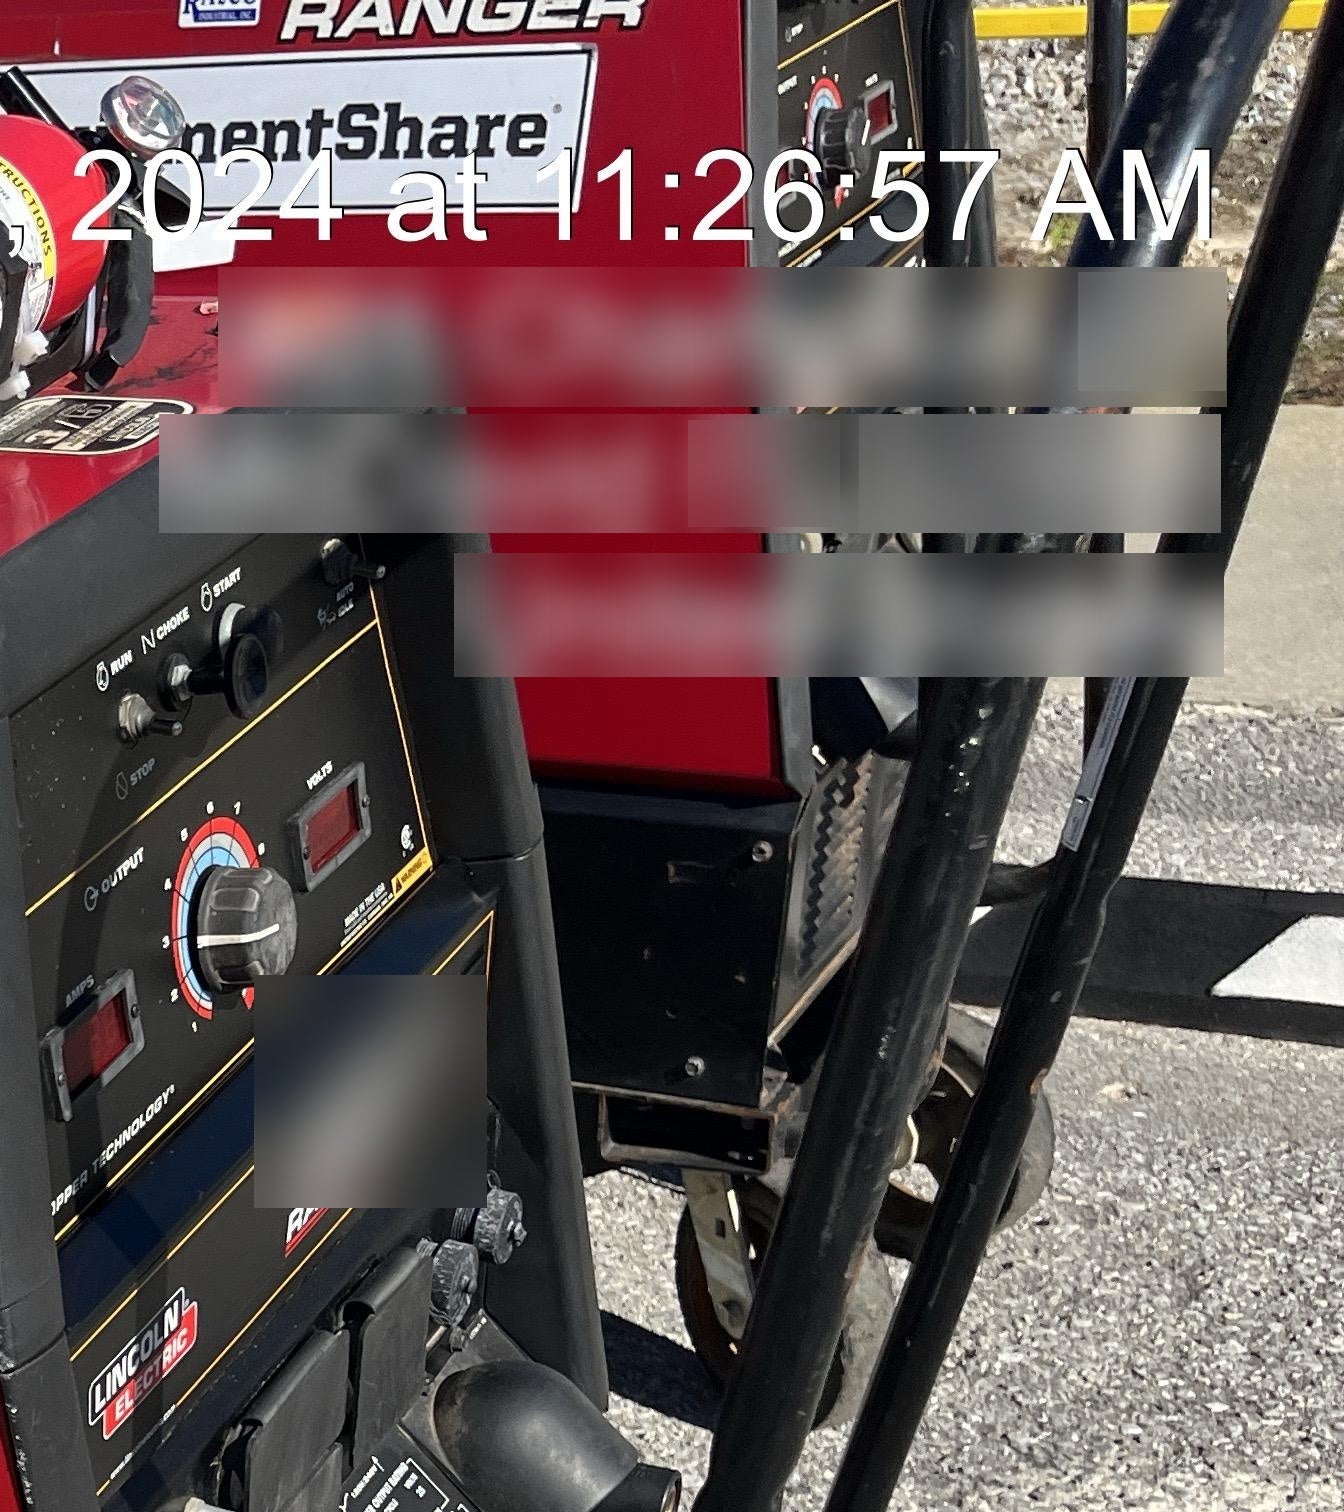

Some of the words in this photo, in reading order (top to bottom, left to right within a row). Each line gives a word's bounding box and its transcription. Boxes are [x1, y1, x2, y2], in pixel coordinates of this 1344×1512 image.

[280, 0, 644, 40] RANGER
[213, 567, 241, 598] START
[157, 606, 190, 640] CHOKE
[110, 650, 132, 676] RUN
[130, 757, 156, 787] STOP
[307, 760, 333, 790] VOLTS
[101, 847, 144, 893] OUTPUT
[66, 975, 95, 1007] AMPS
[95, 1300, 179, 1414] LINCOLN
[115, 1328, 188, 1421] ELECTRIC
